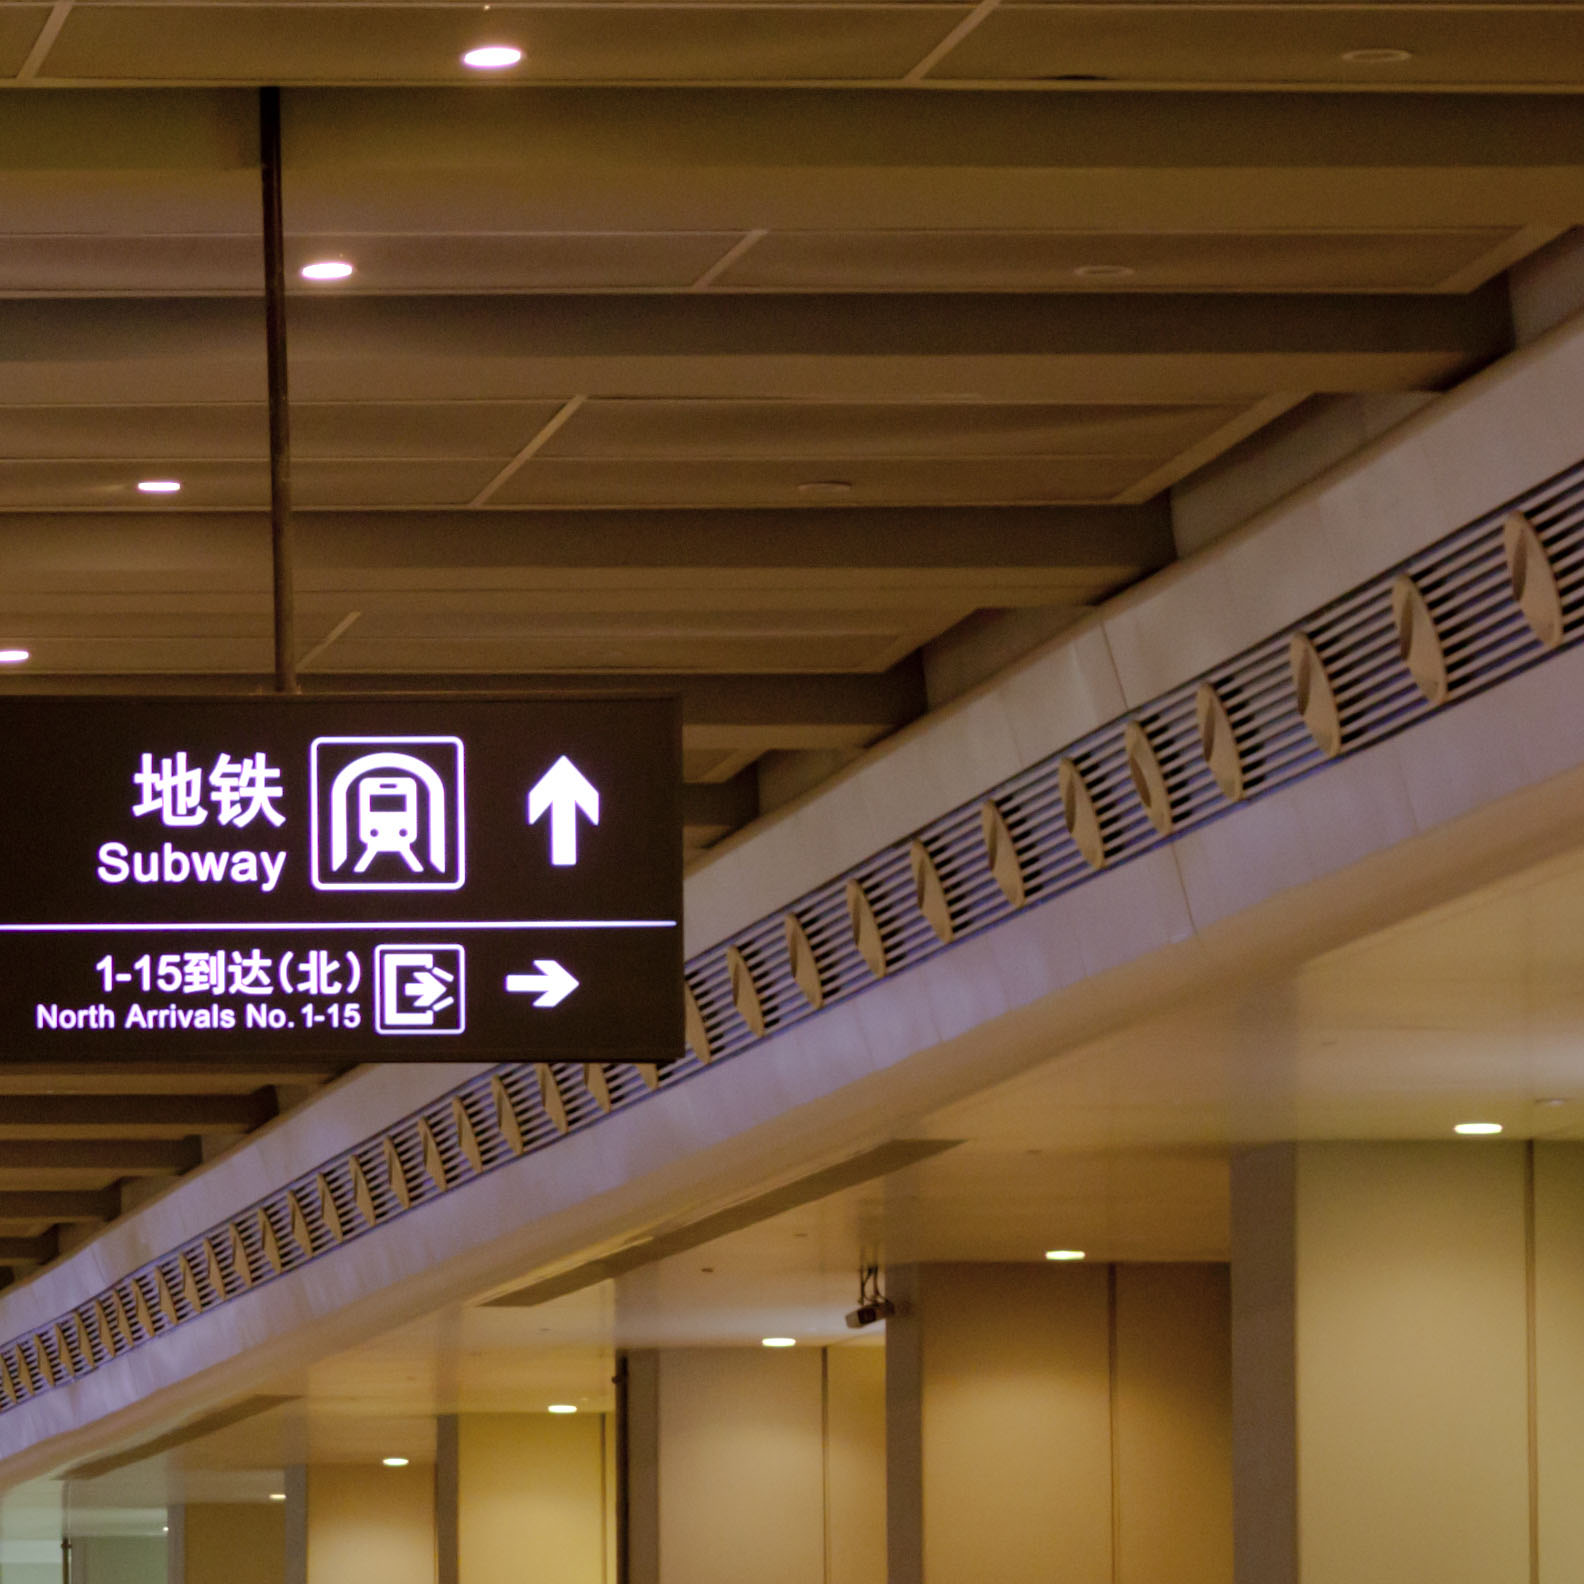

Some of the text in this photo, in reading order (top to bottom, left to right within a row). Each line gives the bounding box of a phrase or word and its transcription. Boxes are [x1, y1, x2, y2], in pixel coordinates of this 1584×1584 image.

[133, 752, 285, 827] 地铁
[98, 842, 286, 891] Subway
[97, 949, 360, 995] 1-15到达(北)
[38, 1004, 114, 1028] North
[125, 1004, 235, 1028] Arrivals
